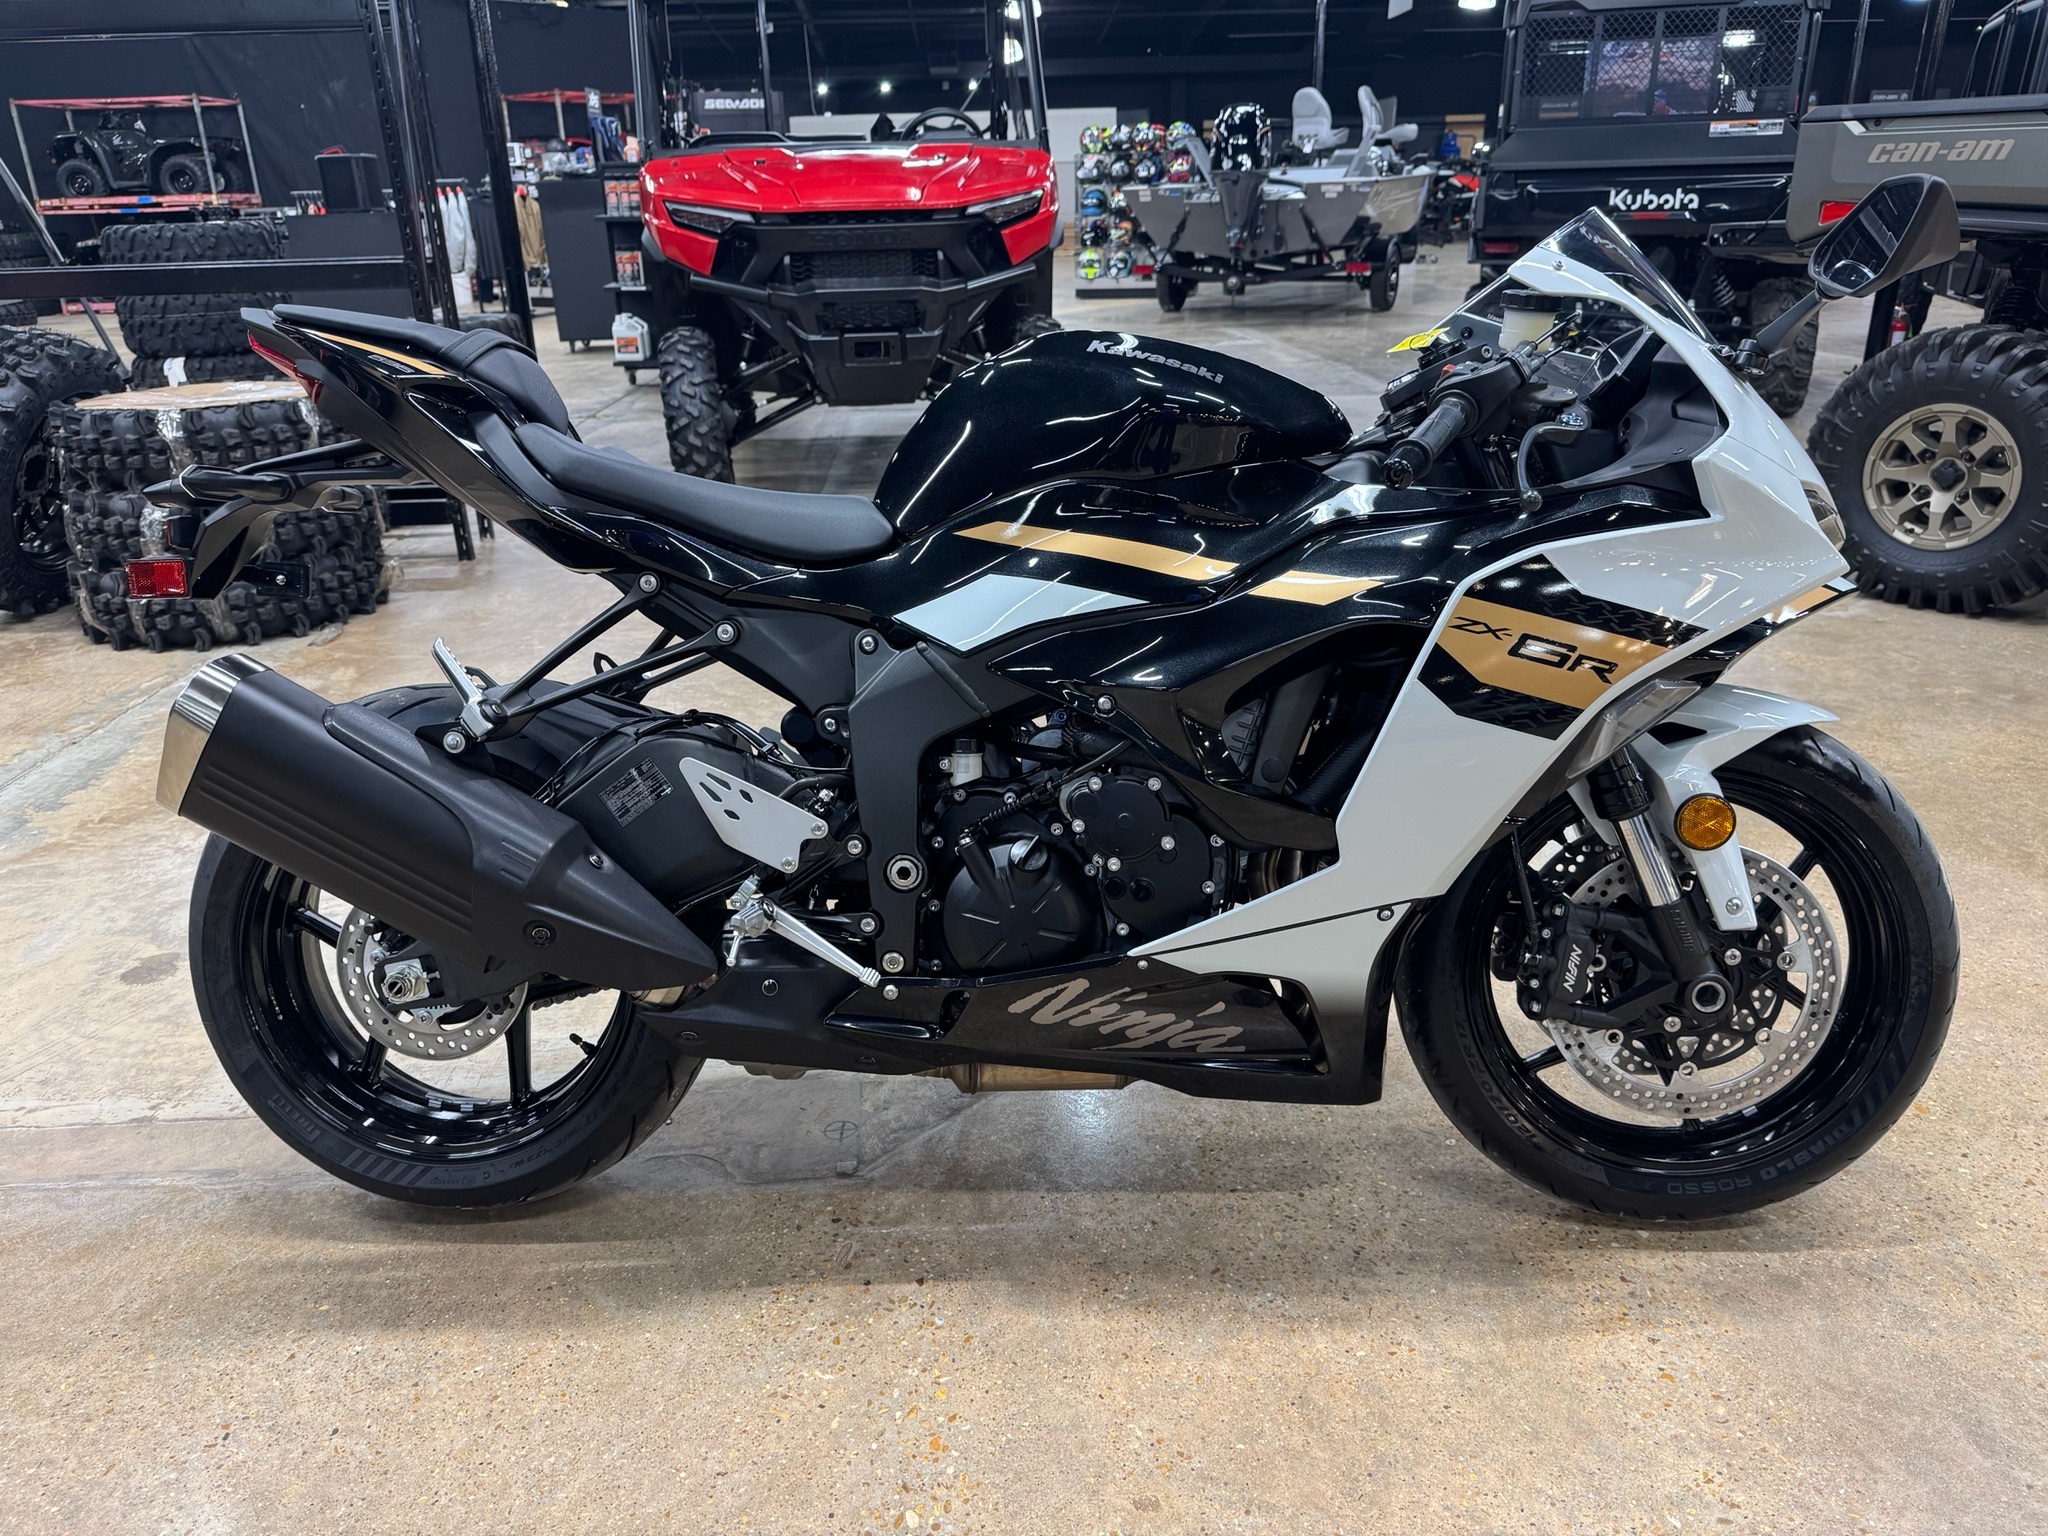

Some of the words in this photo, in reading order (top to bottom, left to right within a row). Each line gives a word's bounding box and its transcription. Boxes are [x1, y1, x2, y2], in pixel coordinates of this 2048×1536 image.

[1867, 138, 2015, 164] can-am
[1609, 188, 1699, 211] Kubota
[806, 227, 923, 246] HONDA
[1086, 340, 1224, 384] Kawasaki
[1447, 616, 1619, 684] ZX-6R
[1562, 943, 1583, 993] NISSIN
[1007, 977, 1247, 1053] Ninja
[265, 1092, 321, 1145] PIRELLI
[1758, 1120, 1852, 1181] DIABLO
[1665, 1174, 1752, 1194] ROSSO
